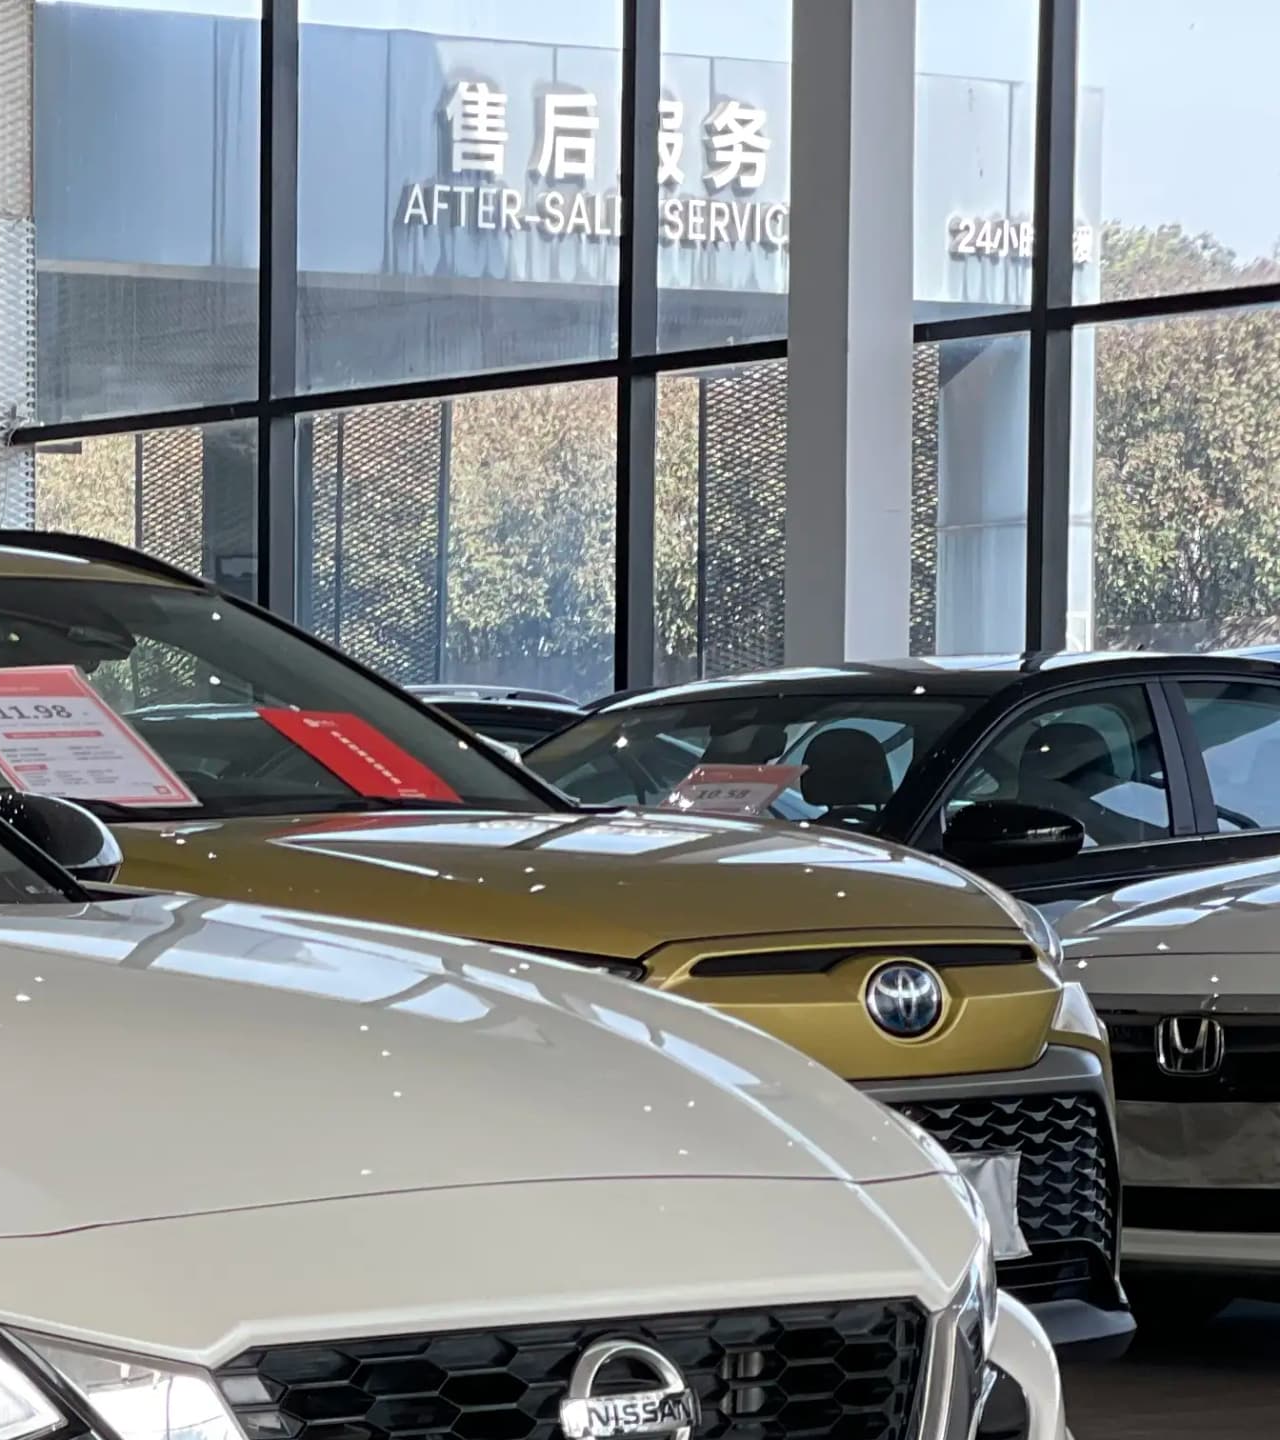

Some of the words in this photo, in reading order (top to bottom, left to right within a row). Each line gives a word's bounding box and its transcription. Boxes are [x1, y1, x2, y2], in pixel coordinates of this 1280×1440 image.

[403, 182, 622, 236] AFTER-SAL
[663, 198, 789, 245] SERVIC
[588, 1398, 693, 1428] NISSAN
